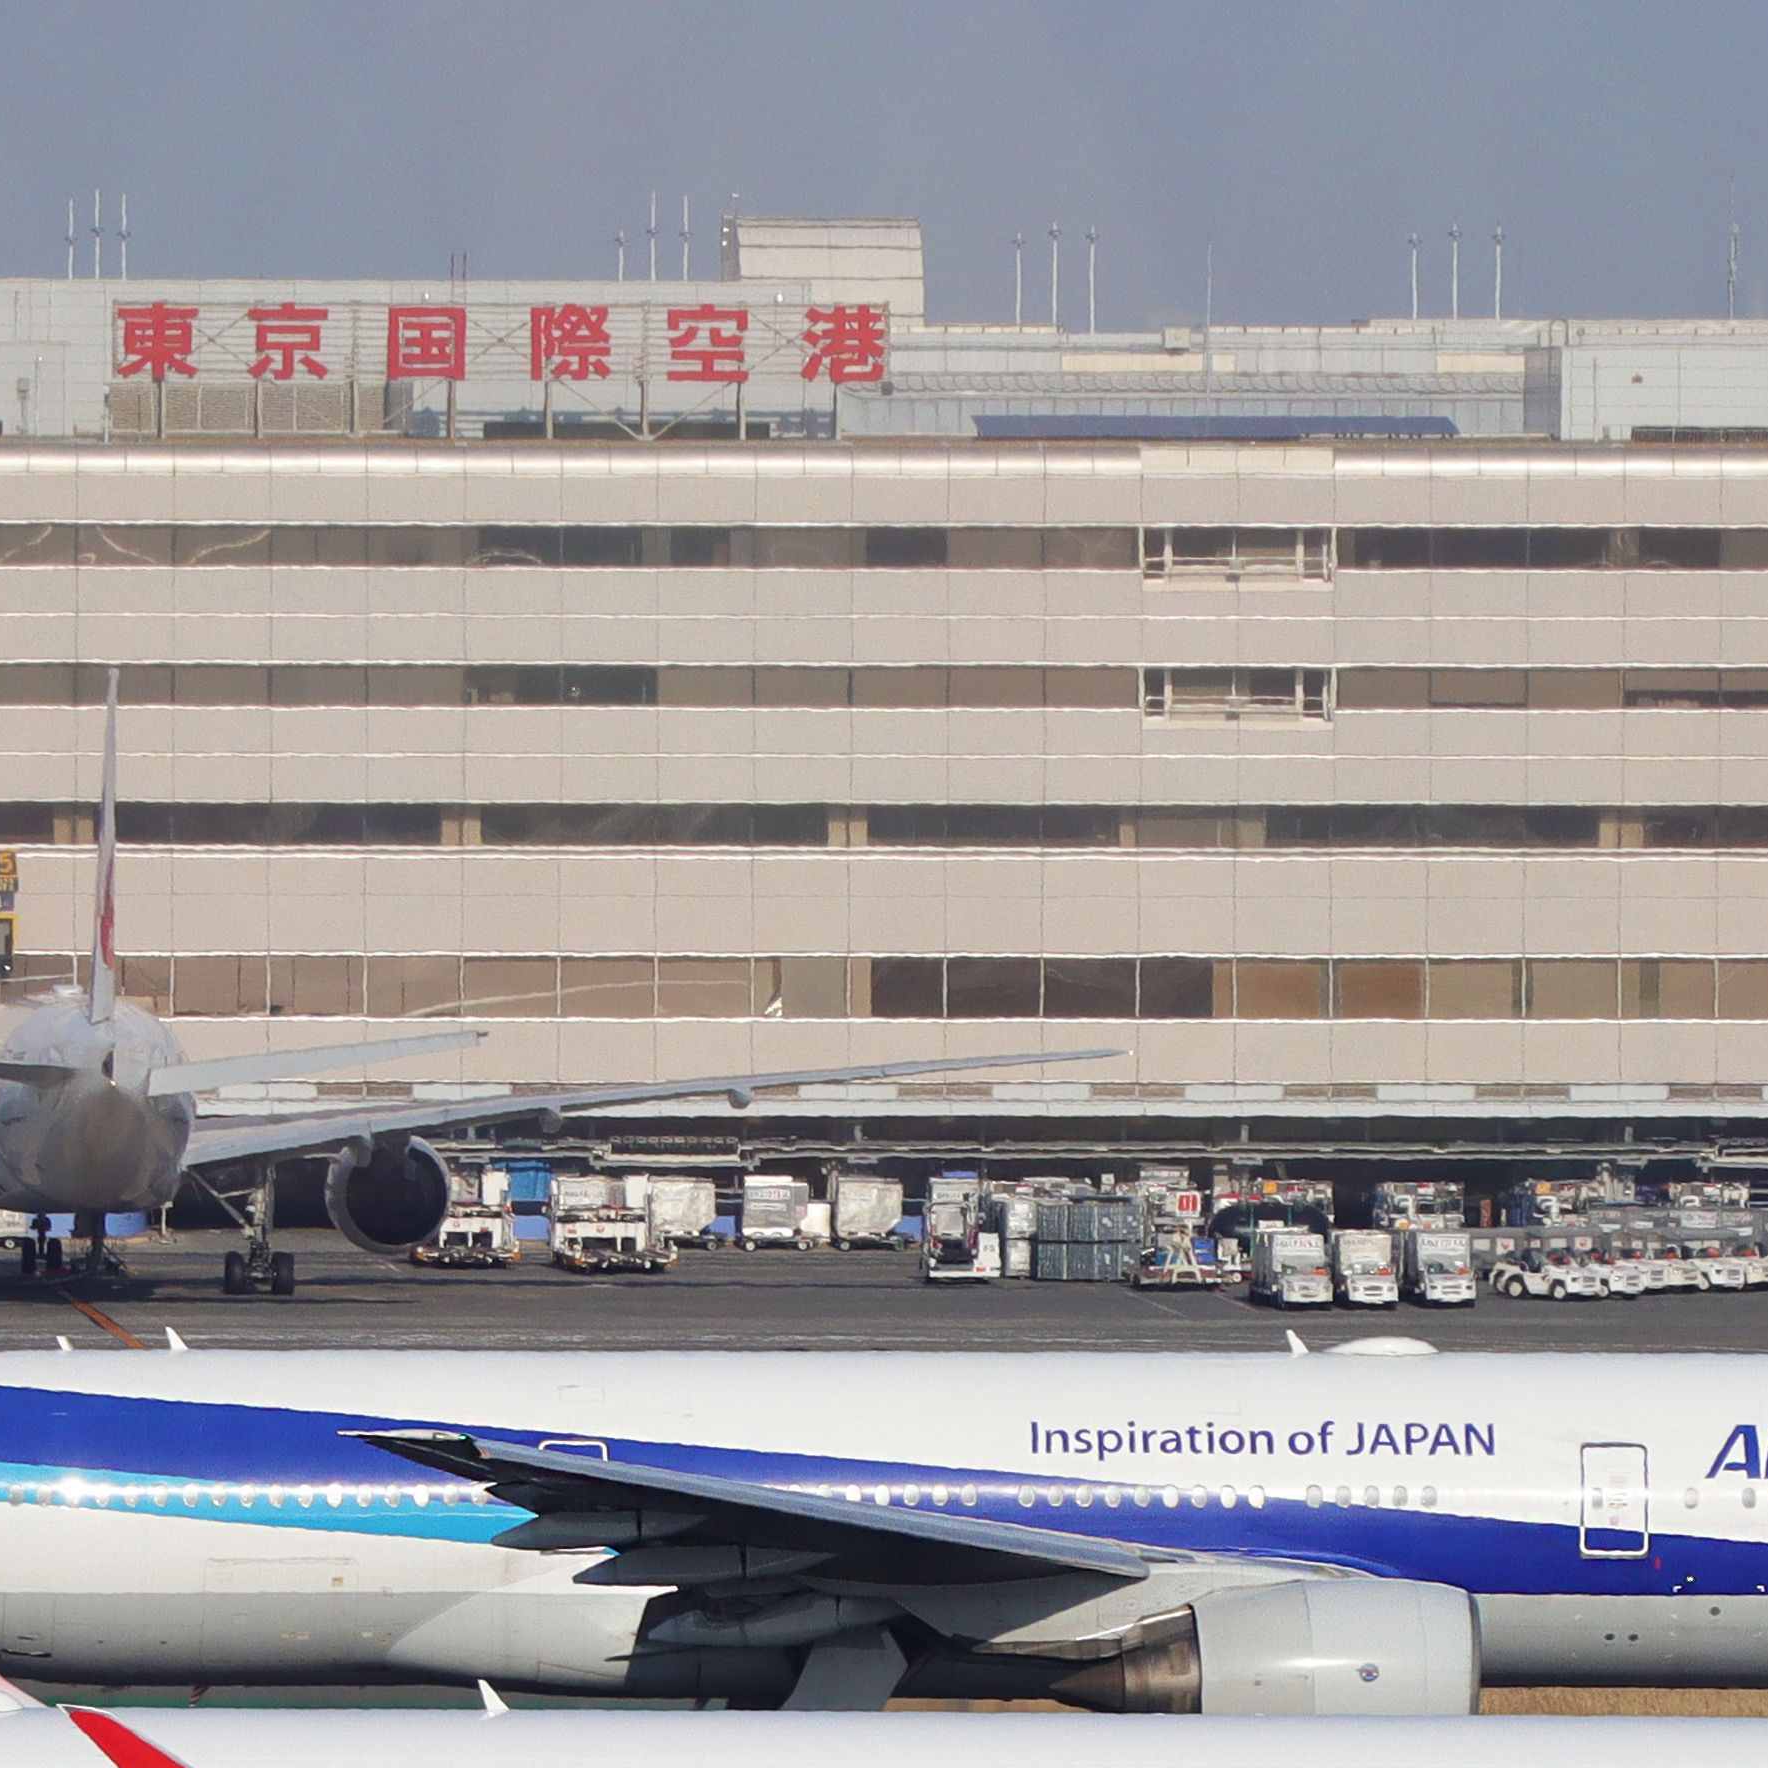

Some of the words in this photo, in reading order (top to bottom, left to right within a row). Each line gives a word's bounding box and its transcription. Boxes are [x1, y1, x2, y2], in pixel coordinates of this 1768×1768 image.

[115, 302, 889, 382] 東京国際空港
[1030, 1420, 1274, 1461] Inspiration
[1288, 1420, 1335, 1455] of
[1345, 1421, 1496, 1457] JAPAN
